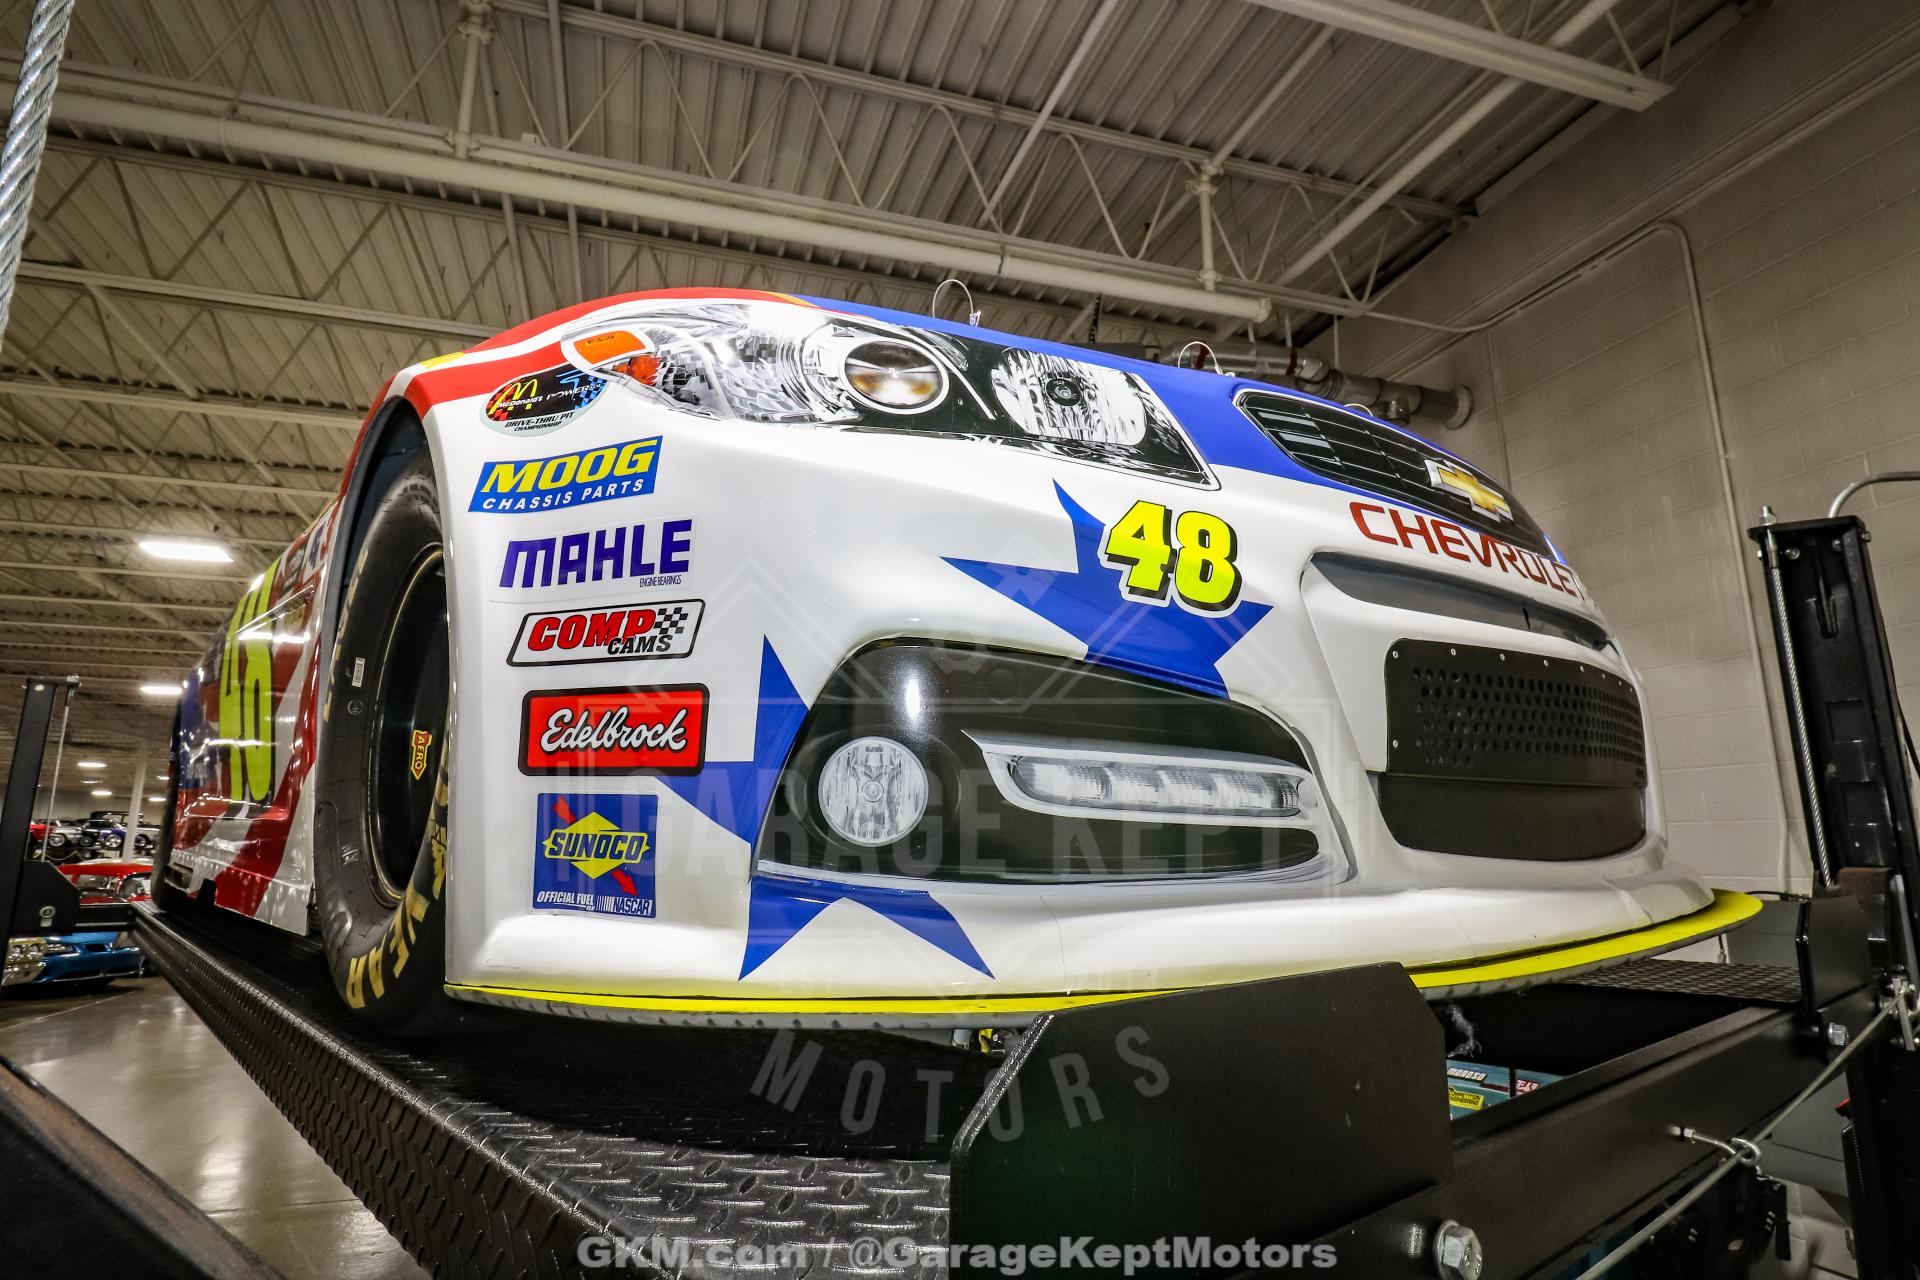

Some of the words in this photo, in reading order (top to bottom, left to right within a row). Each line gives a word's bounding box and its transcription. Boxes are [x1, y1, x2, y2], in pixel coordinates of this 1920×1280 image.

[505, 414, 559, 428] DRIVE-THRU
[560, 411, 575, 422] PIT
[480, 440, 658, 493] MOOG
[482, 491, 573, 510] CHASSIS
[581, 479, 644, 499] PARTS
[499, 519, 692, 588] MAHLE
[1106, 500, 1241, 609] 48
[640, 577, 657, 587] ENGINE
[658, 575, 681, 586] BEARINGS
[527, 609, 657, 651] COMP
[607, 634, 673, 655] CAMS
[540, 706, 688, 752] Edelbrock
[415, 736, 426, 769] AERO
[548, 831, 648, 862] SUNOCO
[537, 891, 576, 904] OFFICIAL
[577, 893, 595, 906] FUEL
[614, 896, 653, 916] NASCAR
